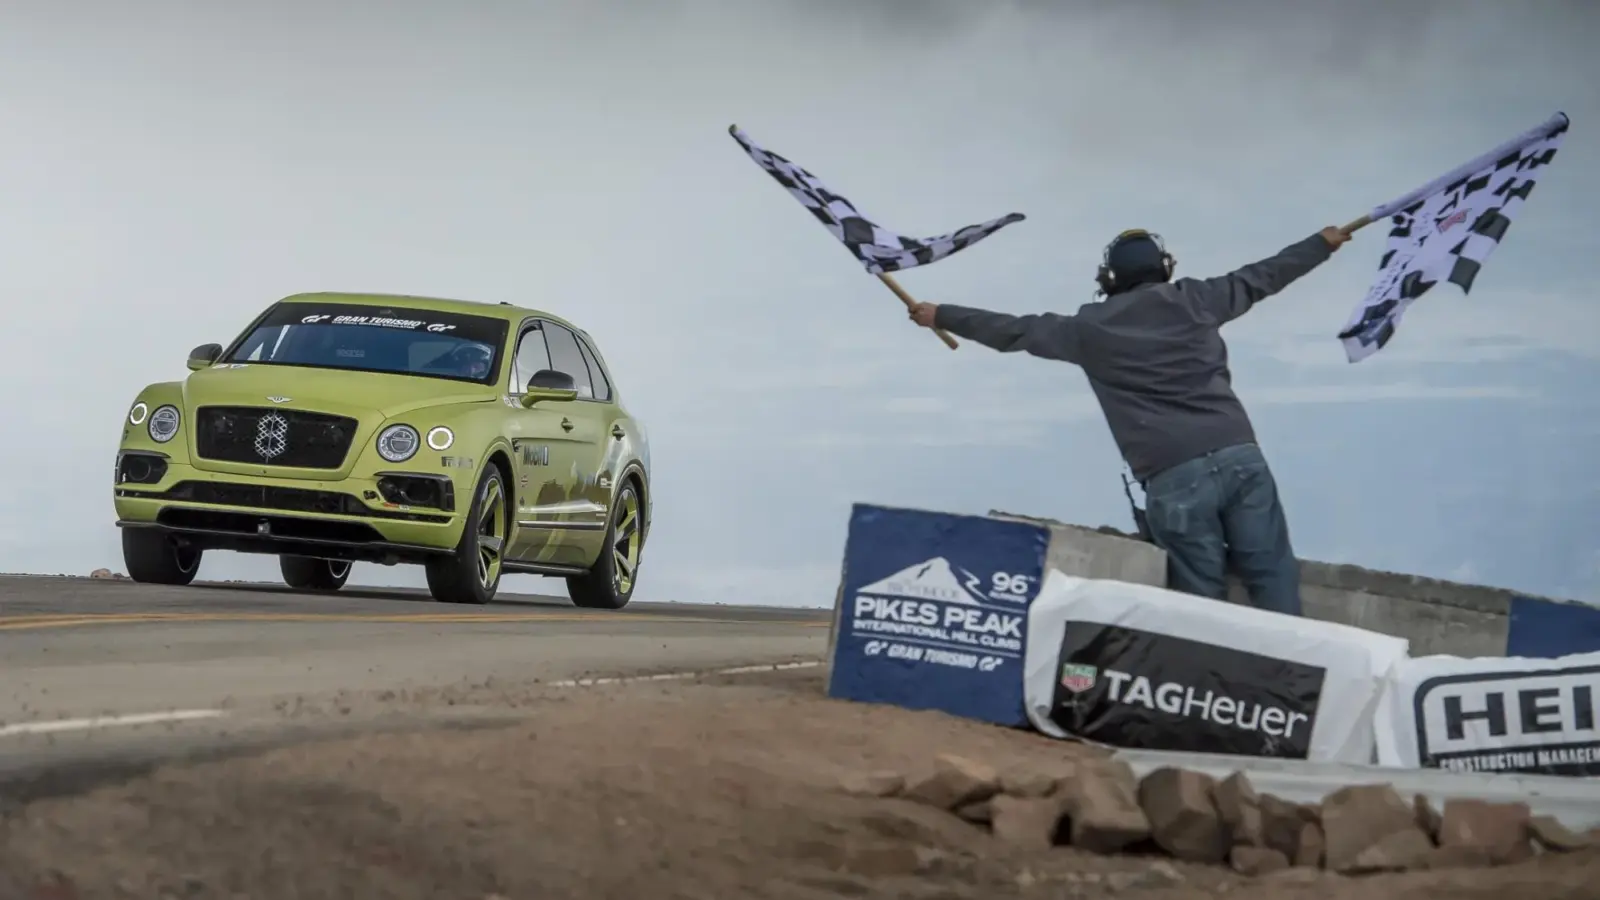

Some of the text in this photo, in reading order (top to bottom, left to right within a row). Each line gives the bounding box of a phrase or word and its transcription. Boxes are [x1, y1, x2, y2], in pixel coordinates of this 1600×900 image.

[334, 315, 368, 323] GRAN
[369, 317, 421, 327] TURISMO
[854, 597, 1023, 638] PIKES PEAK
[853, 620, 1021, 650] INTERNATIONAL HILL CLIMB
[888, 644, 923, 659] GRAN
[1443, 685, 1594, 740] HEI
[1439, 751, 1536, 773] CONSTRUCTION
